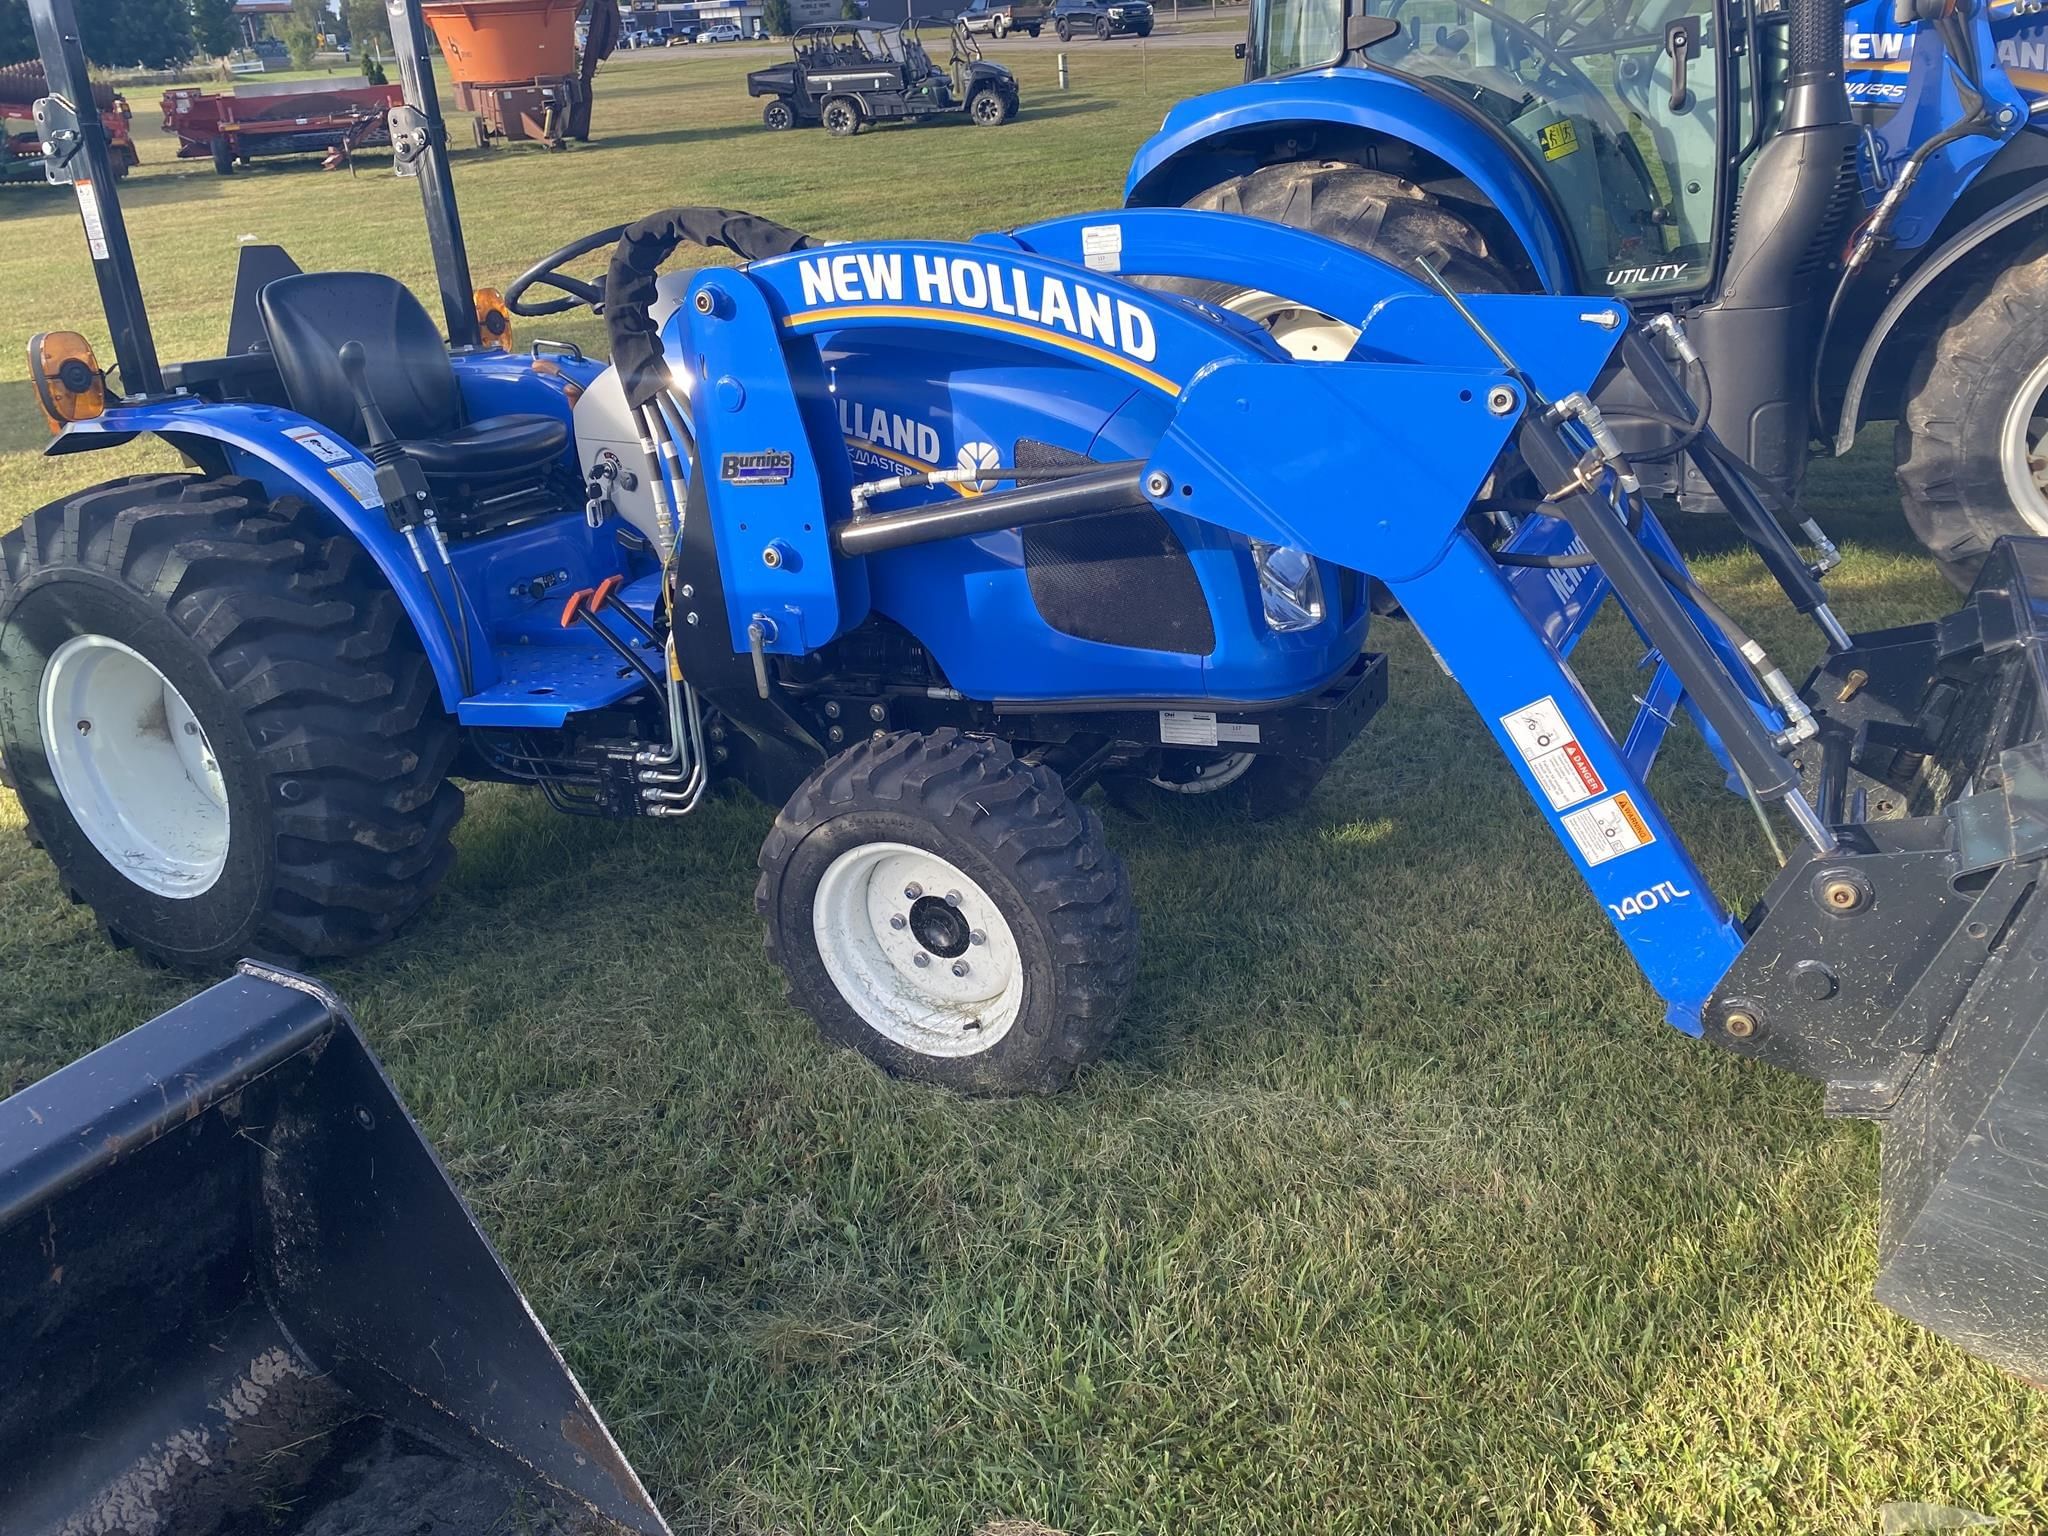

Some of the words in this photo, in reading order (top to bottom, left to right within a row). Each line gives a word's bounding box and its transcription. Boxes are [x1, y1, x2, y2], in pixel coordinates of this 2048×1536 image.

[1606, 263, 1689, 285] UTILITY
[798, 254, 903, 306] NEW
[913, 254, 1157, 363] HOLLAND
[833, 398, 940, 464] LLAND
[721, 449, 791, 479] Burnips
[1573, 756, 1598, 791] DANGER
[1624, 808, 1646, 839] WARNING
[1607, 880, 1691, 921] 140TL
